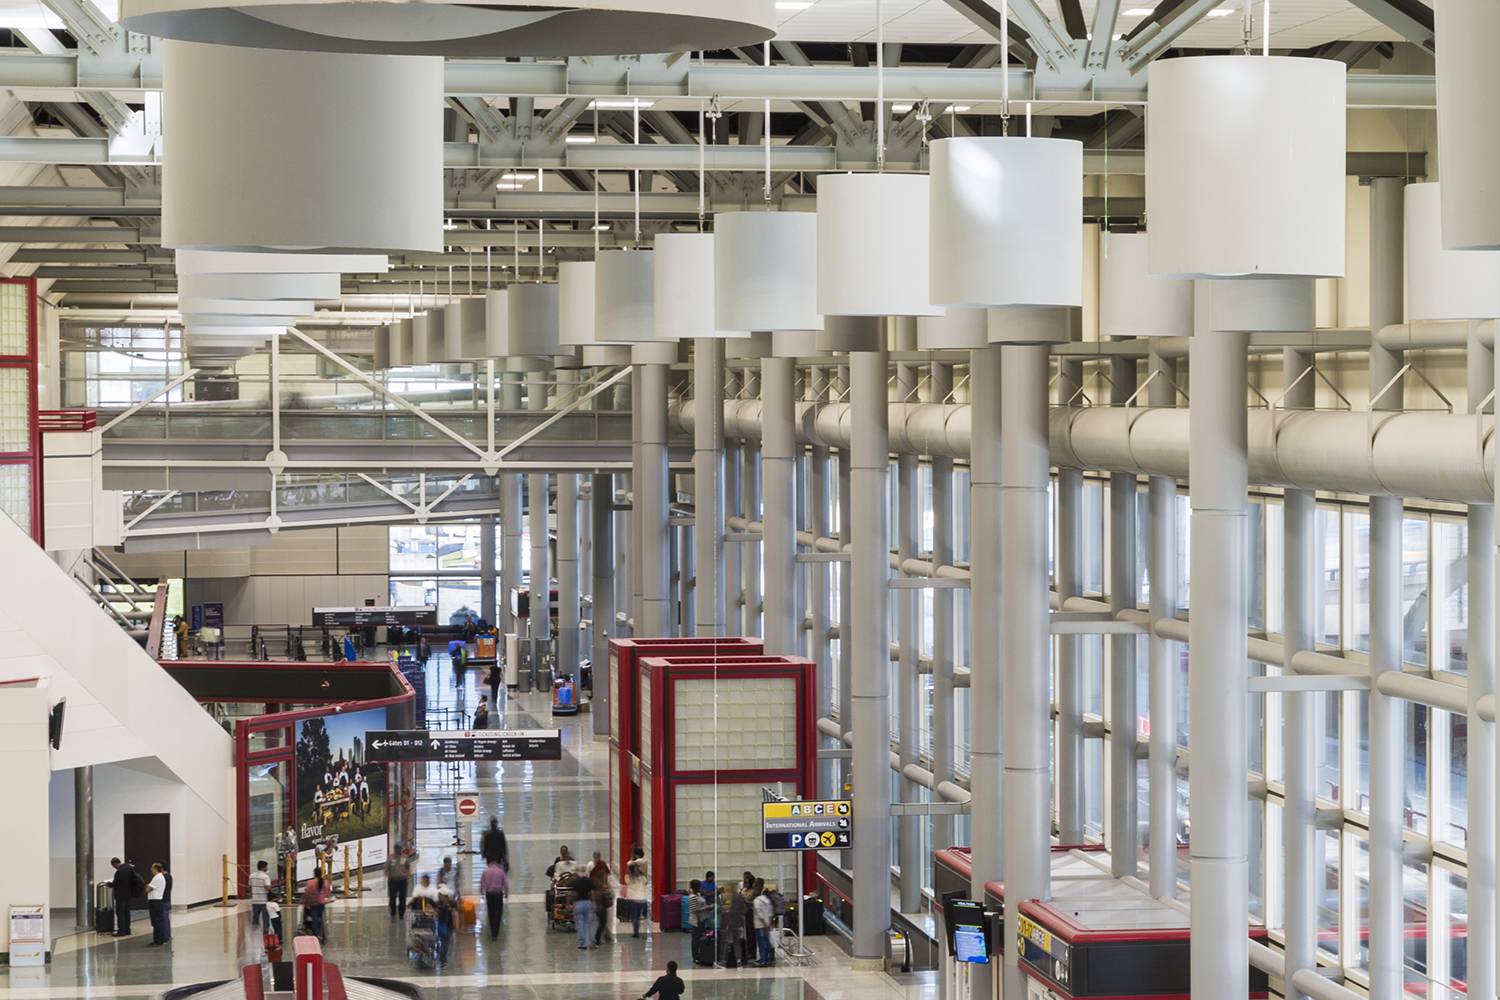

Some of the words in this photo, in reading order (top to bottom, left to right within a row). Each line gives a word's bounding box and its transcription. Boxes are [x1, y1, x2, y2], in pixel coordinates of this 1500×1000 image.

[792, 806, 800, 814] A
[803, 806, 811, 814] B
[815, 805, 823, 813] C
[826, 805, 834, 813] E
[301, 823, 323, 839] flavor
[792, 834, 802, 847] P
